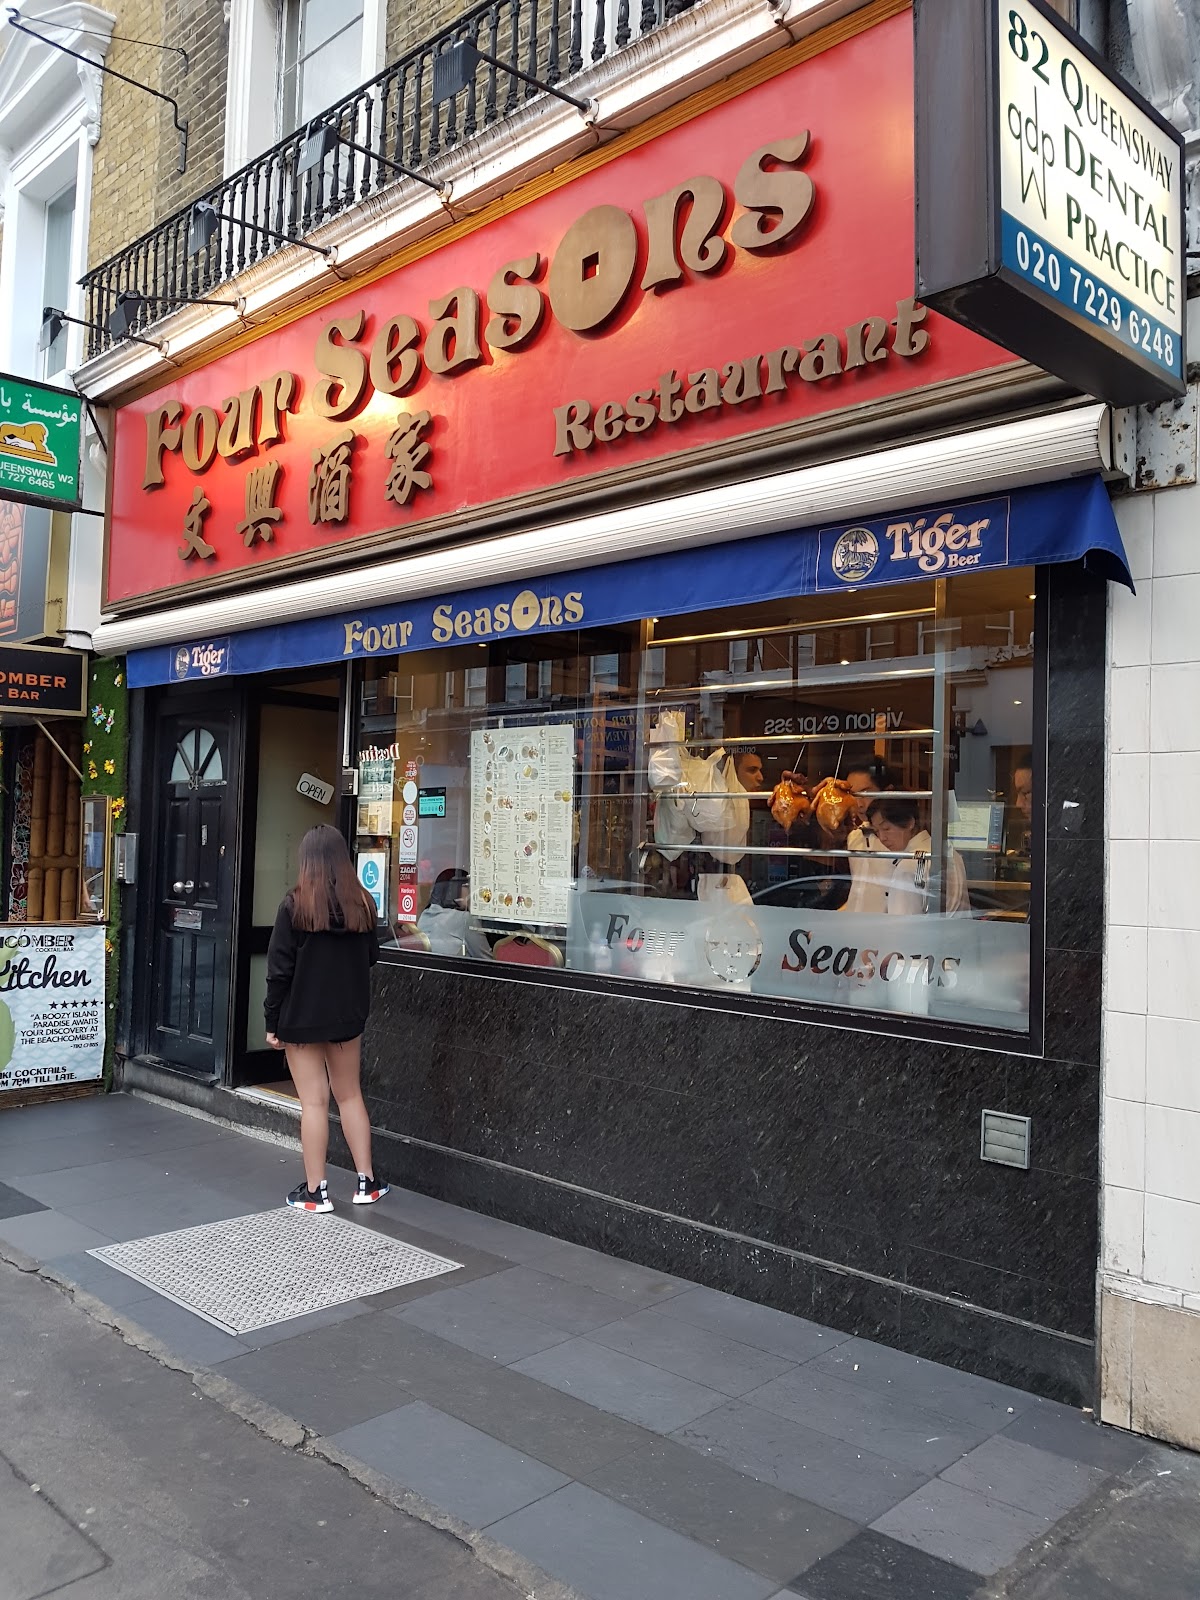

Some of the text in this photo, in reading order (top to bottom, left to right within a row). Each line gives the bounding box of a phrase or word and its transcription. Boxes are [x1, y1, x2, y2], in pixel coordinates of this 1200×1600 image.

[1008, 10, 1173, 194] 82 QUEENSWAY
[1064, 124, 1174, 255] DENTAL
[1066, 192, 1175, 315] PRACTICE
[1016, 231, 1173, 367] 020 7229 6248
[552, 296, 931, 457] Restaurant
[142, 370, 296, 490] Four
[8, 471, 26, 483] 727
[28, 477, 55, 490] 6465
[58, 473, 74, 485] W2
[885, 513, 991, 572] Tiger
[947, 553, 982, 569] Beer
[343, 620, 413, 655] Four
[192, 643, 225, 675] Tiger
[188, 775, 198, 790] 84
[299, 781, 327, 801] OPEN
[400, 866, 417, 874] ZAGAT
[781, 928, 962, 988] Seasons
[33, 1018, 99, 1028] PARADISE AWAITS
[42, 1012, 71, 1020] BOOZY
[72, 1010, 99, 1018] ISLAND
[20, 1029, 44, 1037] YOUR
[45, 1026, 88, 1036] DISCOVERY
[12, 1077, 30, 1087] 7PM
[34, 1075, 52, 1084] TILL
[15, 1066, 67, 1077] COCKTAILS
